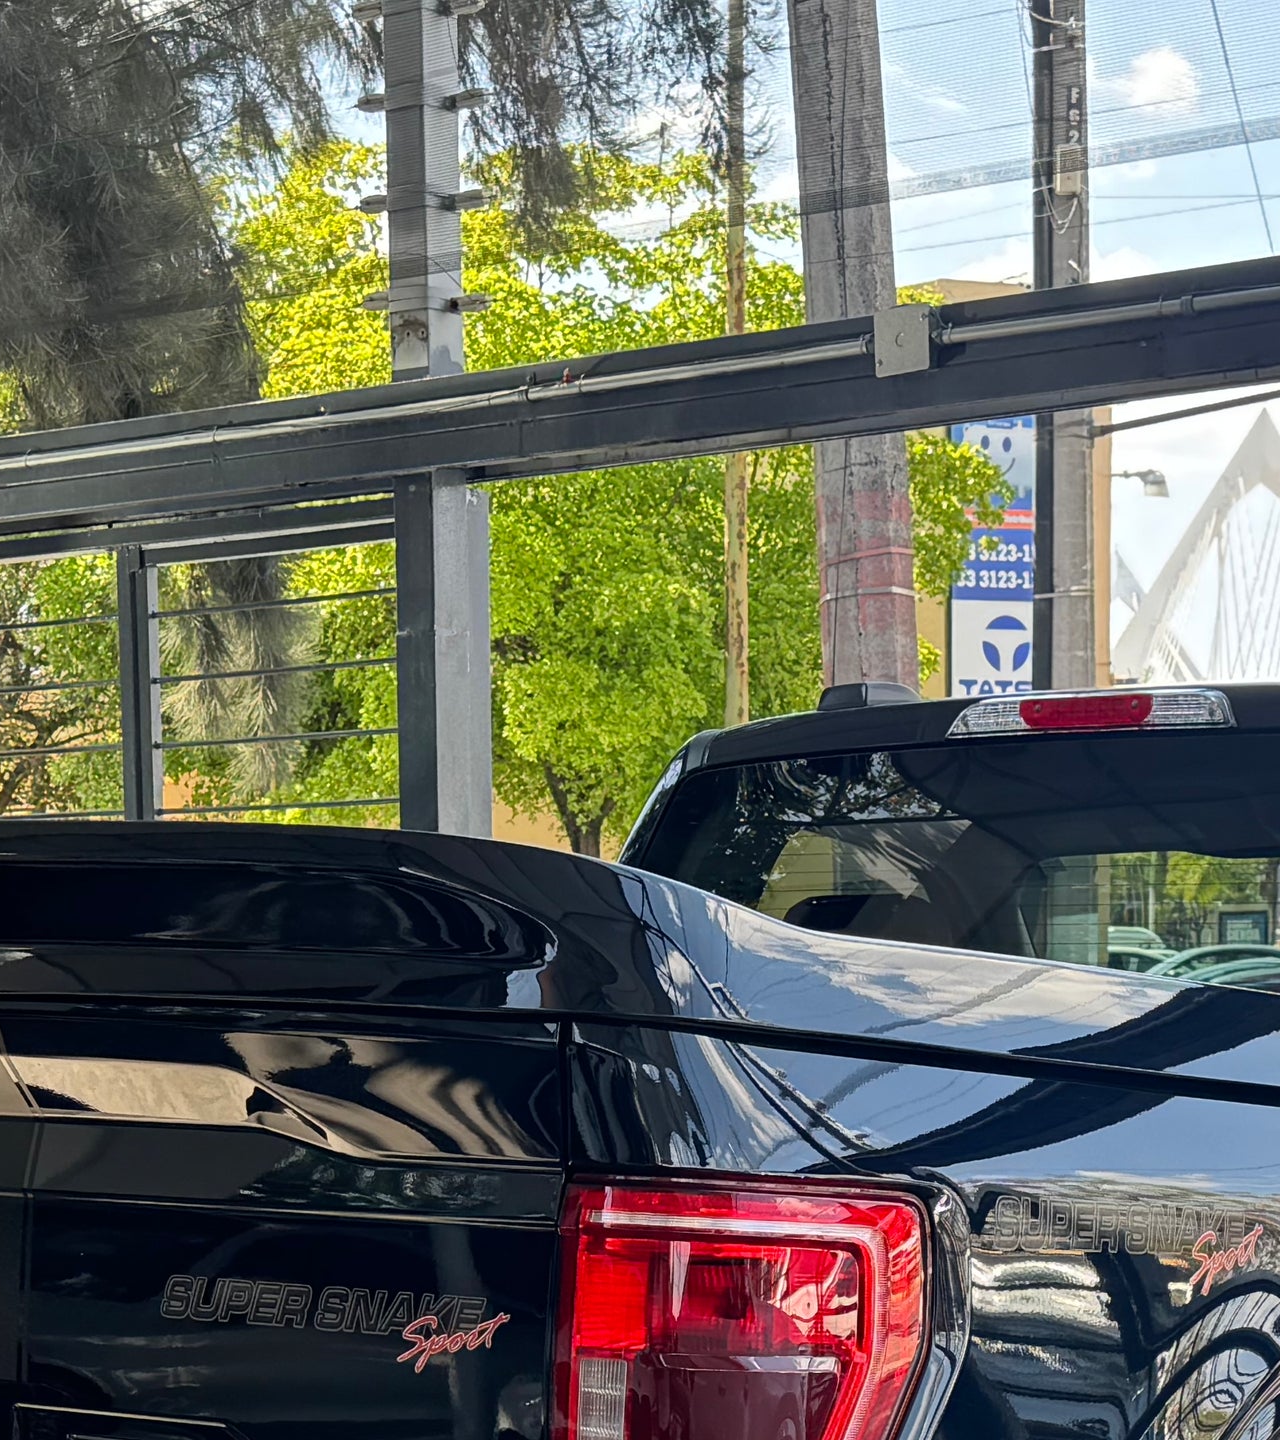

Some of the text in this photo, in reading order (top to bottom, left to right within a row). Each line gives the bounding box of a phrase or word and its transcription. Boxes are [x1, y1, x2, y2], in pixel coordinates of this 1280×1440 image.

[979, 569, 1034, 589] 3123-1
[994, 1195, 1248, 1256] SUPER SNAKE
[1188, 1222, 1265, 1297] Sport
[160, 1275, 487, 1336] SUPER SNAKE
[396, 1312, 511, 1374] Sport
